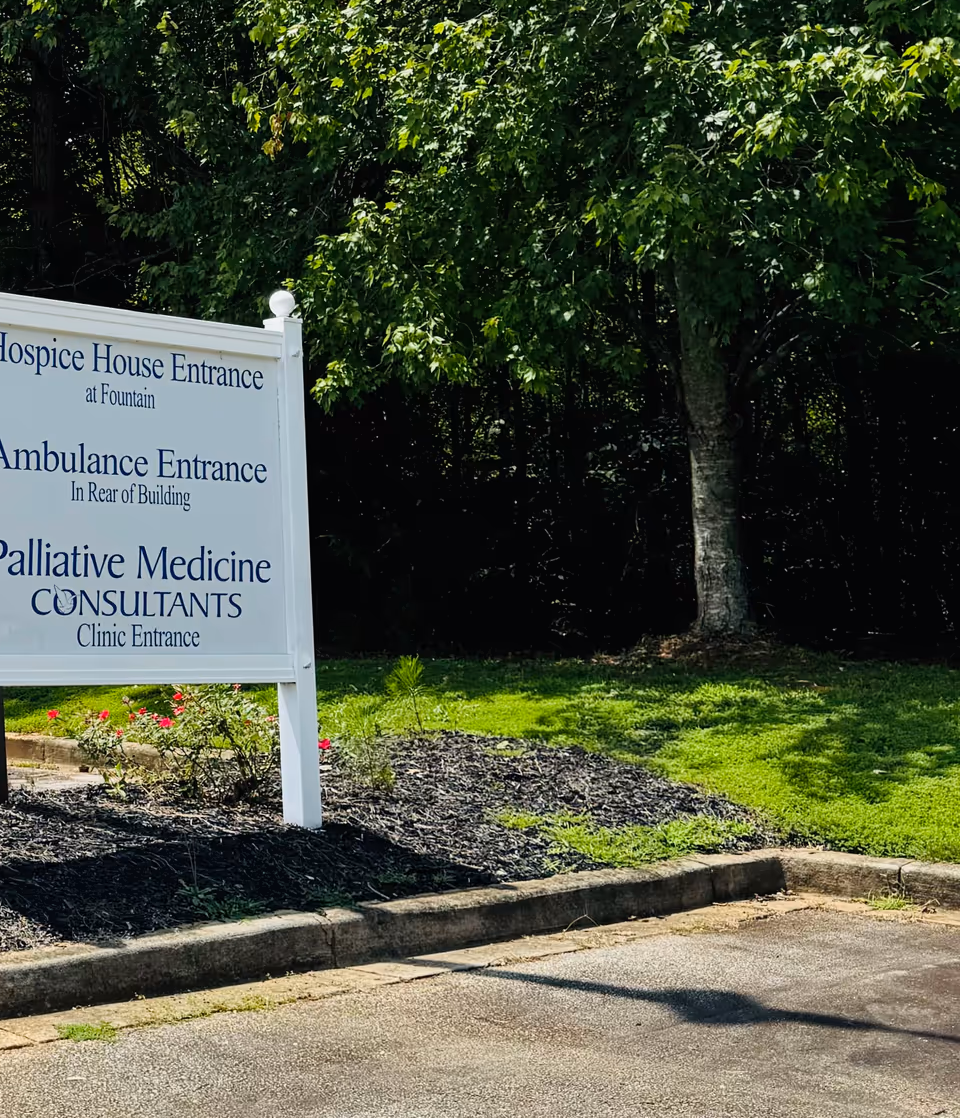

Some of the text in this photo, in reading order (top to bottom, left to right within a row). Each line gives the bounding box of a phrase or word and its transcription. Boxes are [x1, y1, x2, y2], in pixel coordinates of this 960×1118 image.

[91, 342, 165, 380] House
[169, 352, 264, 391] Entrance
[85, 382, 156, 410] at Fountain
[156, 448, 268, 484] Entrance
[70, 480, 191, 512] In Rear of Building
[136, 545, 272, 584] Medicine
[30, 584, 243, 619] CONSULTANTS
[76, 622, 201, 648] Clinic Entrance
